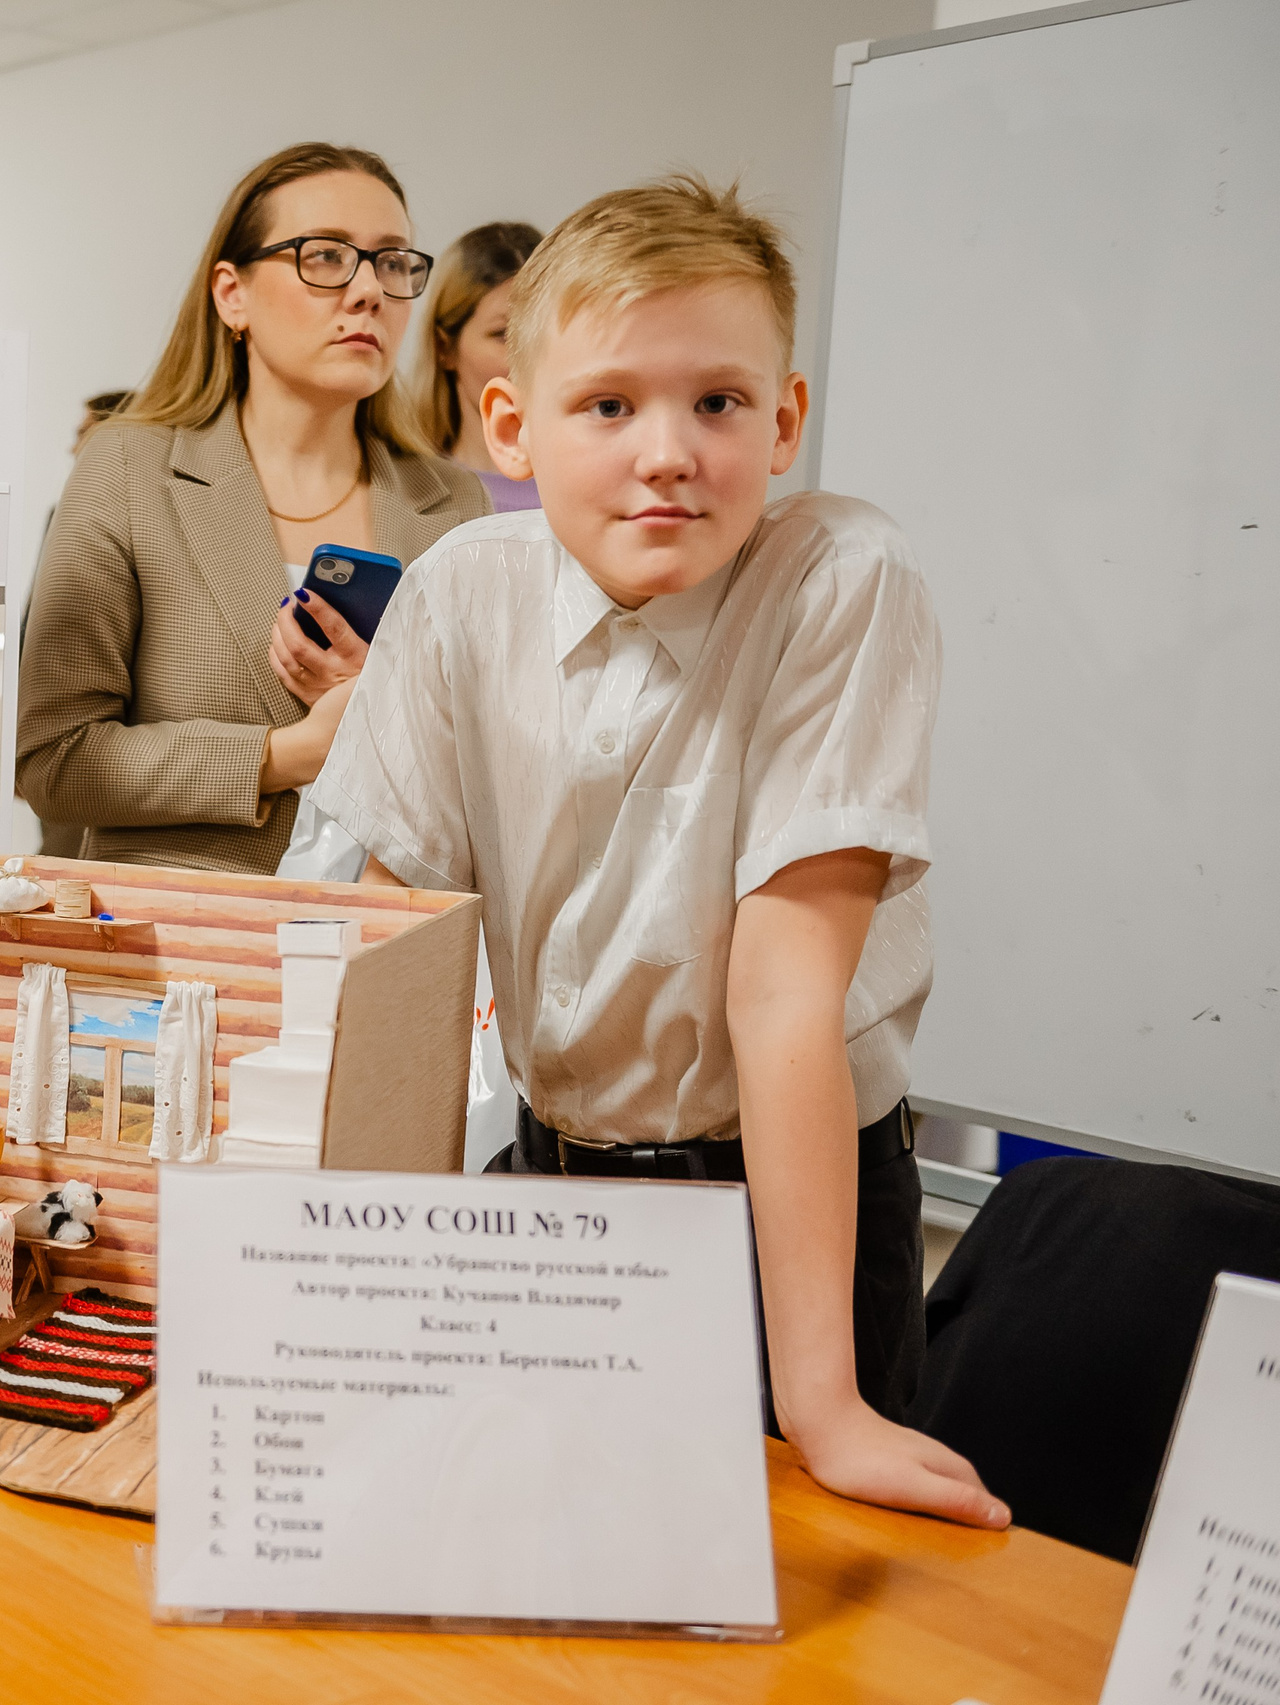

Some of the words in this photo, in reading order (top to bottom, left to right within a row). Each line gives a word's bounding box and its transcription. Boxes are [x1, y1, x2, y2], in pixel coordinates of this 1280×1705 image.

[301, 1200, 414, 1231] МАОУ
[426, 1205, 516, 1237] СОШ
[528, 1210, 564, 1240] №
[573, 1213, 608, 1240] 79
[421, 1316, 480, 1333] Класс:
[488, 1320, 496, 1333] 4
